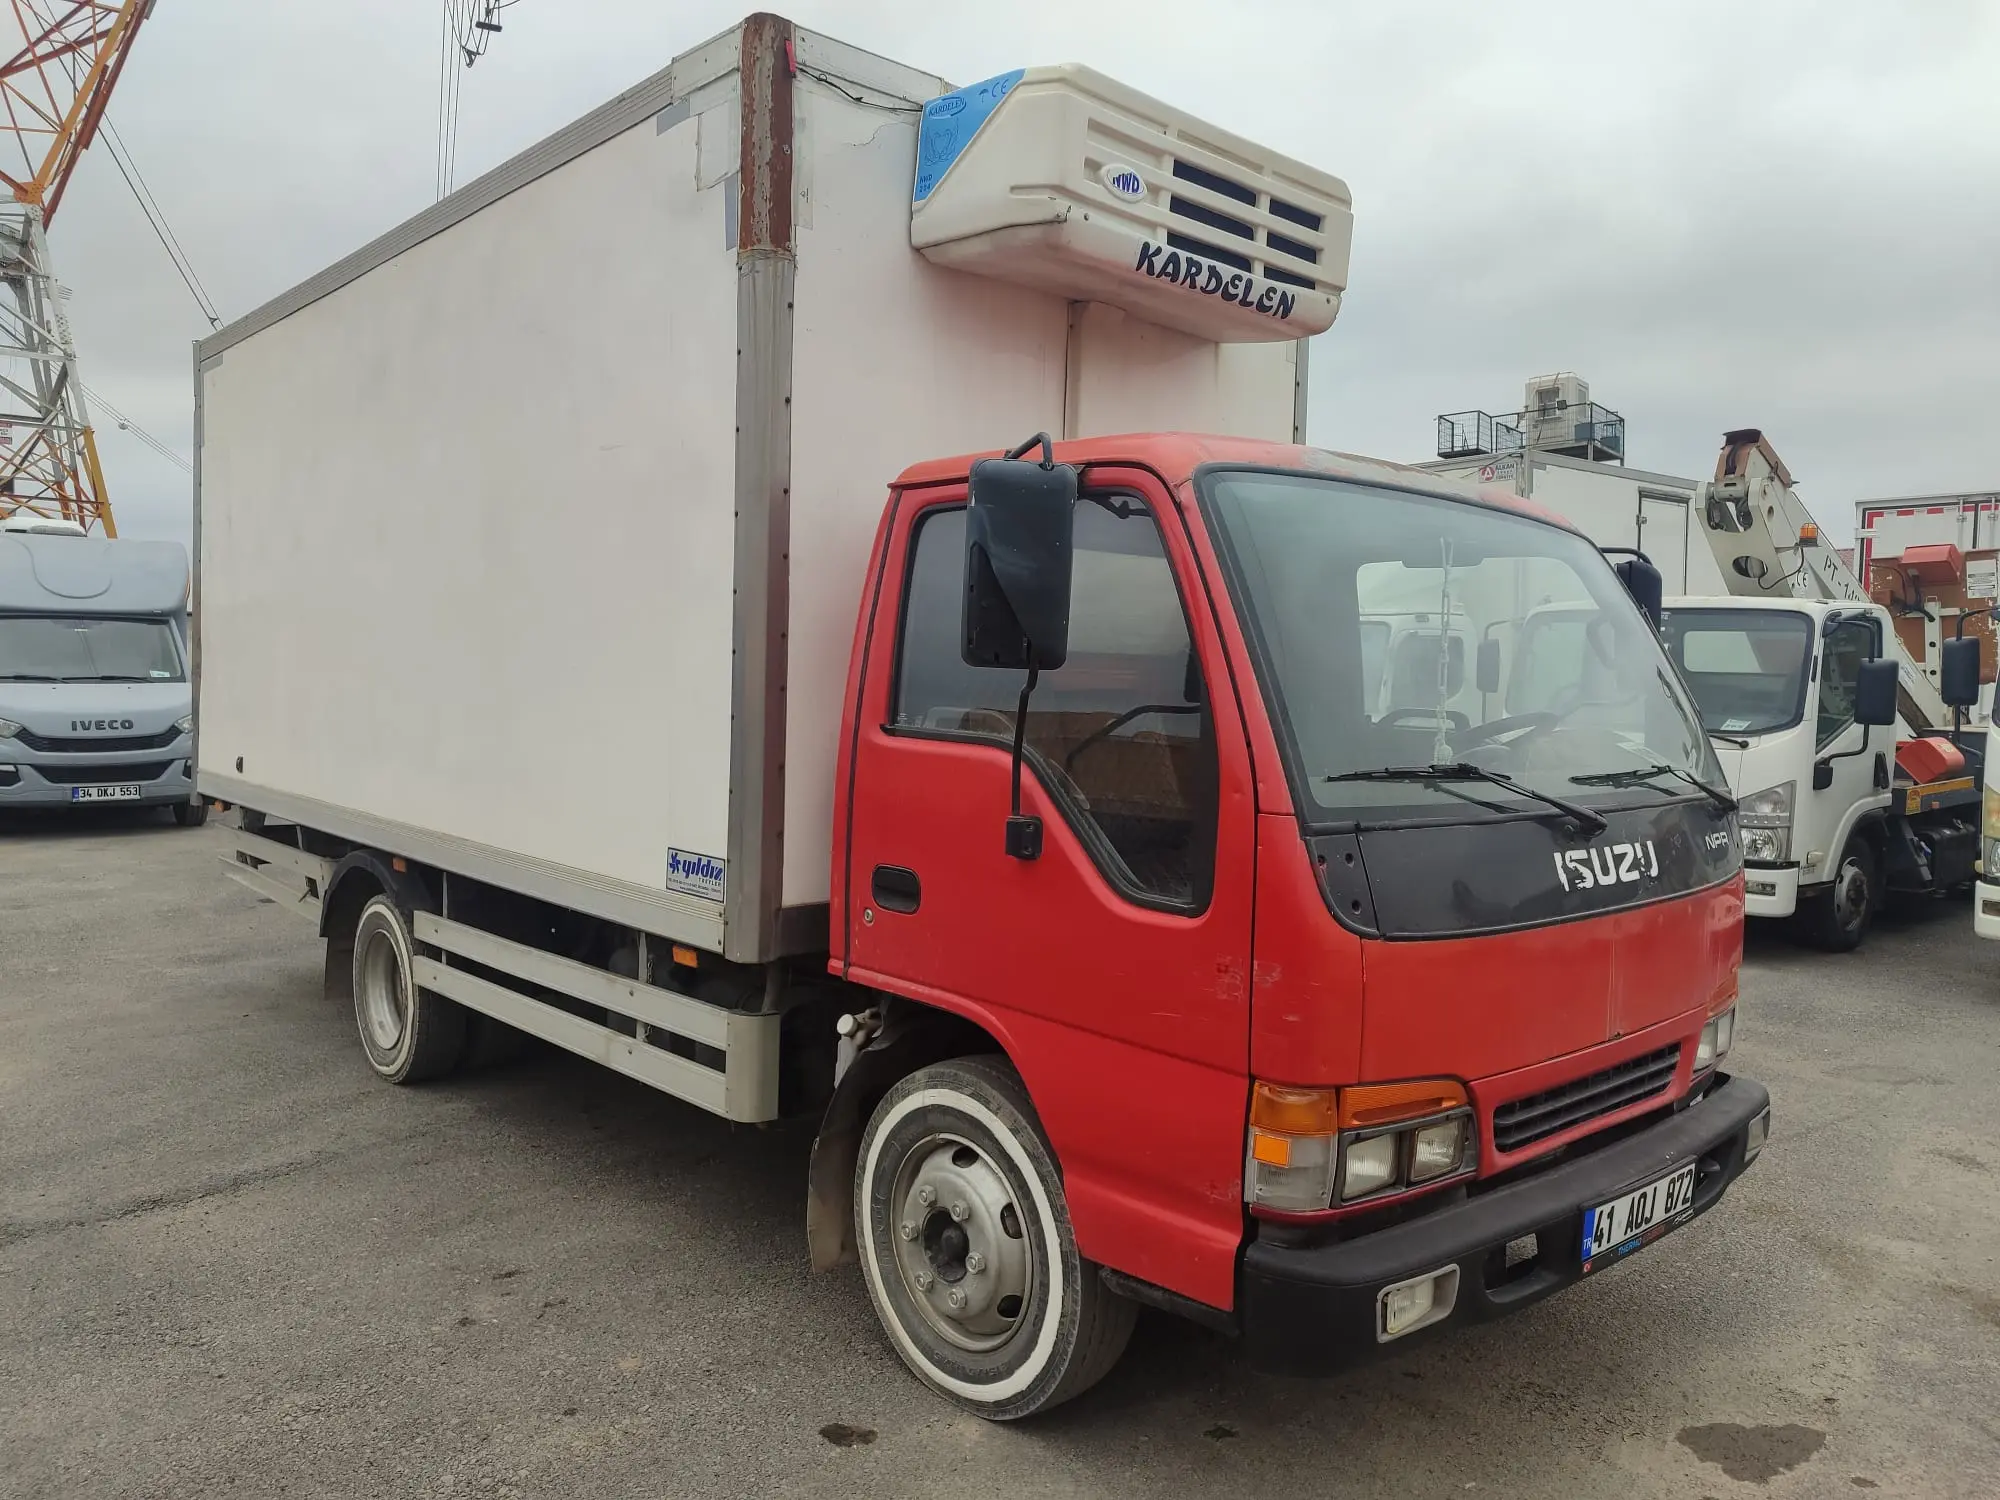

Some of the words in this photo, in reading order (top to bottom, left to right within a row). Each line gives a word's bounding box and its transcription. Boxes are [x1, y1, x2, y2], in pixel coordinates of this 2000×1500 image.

[928, 98, 965, 117] KARDELEN
[1135, 241, 1295, 320] KARDELEN
[71, 719, 134, 731] IVECO
[80, 788, 92, 798] 34
[97, 787, 115, 797] DKJ
[120, 786, 138, 795] 553
[1704, 832, 1729, 850] NPR
[1553, 840, 1659, 892] ISUZU
[1593, 1206, 1615, 1248] 41
[1624, 1186, 1658, 1236] AOJ
[1664, 1168, 1694, 1215] 872
